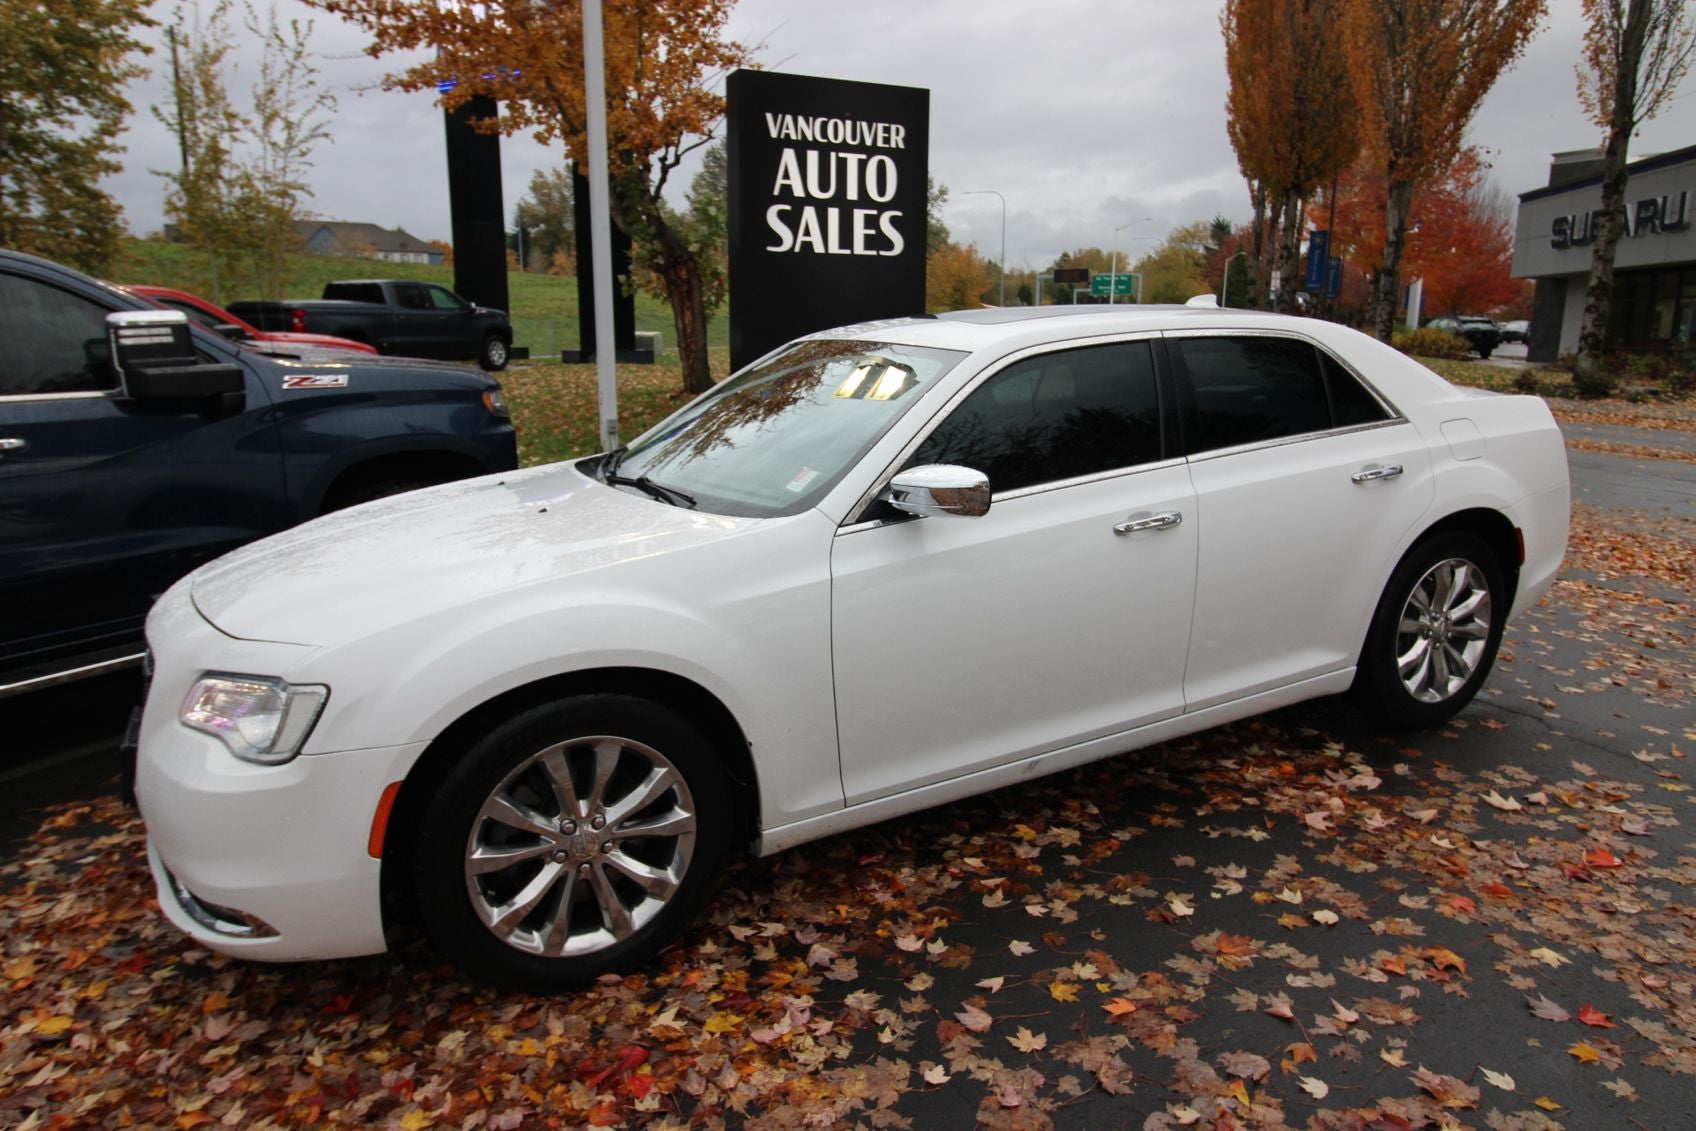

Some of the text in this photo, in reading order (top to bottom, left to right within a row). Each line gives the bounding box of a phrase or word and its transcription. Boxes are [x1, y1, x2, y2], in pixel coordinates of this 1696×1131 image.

[765, 112, 906, 149] VANCOUVER
[773, 148, 898, 203] AUTO
[765, 204, 905, 256] SALES
